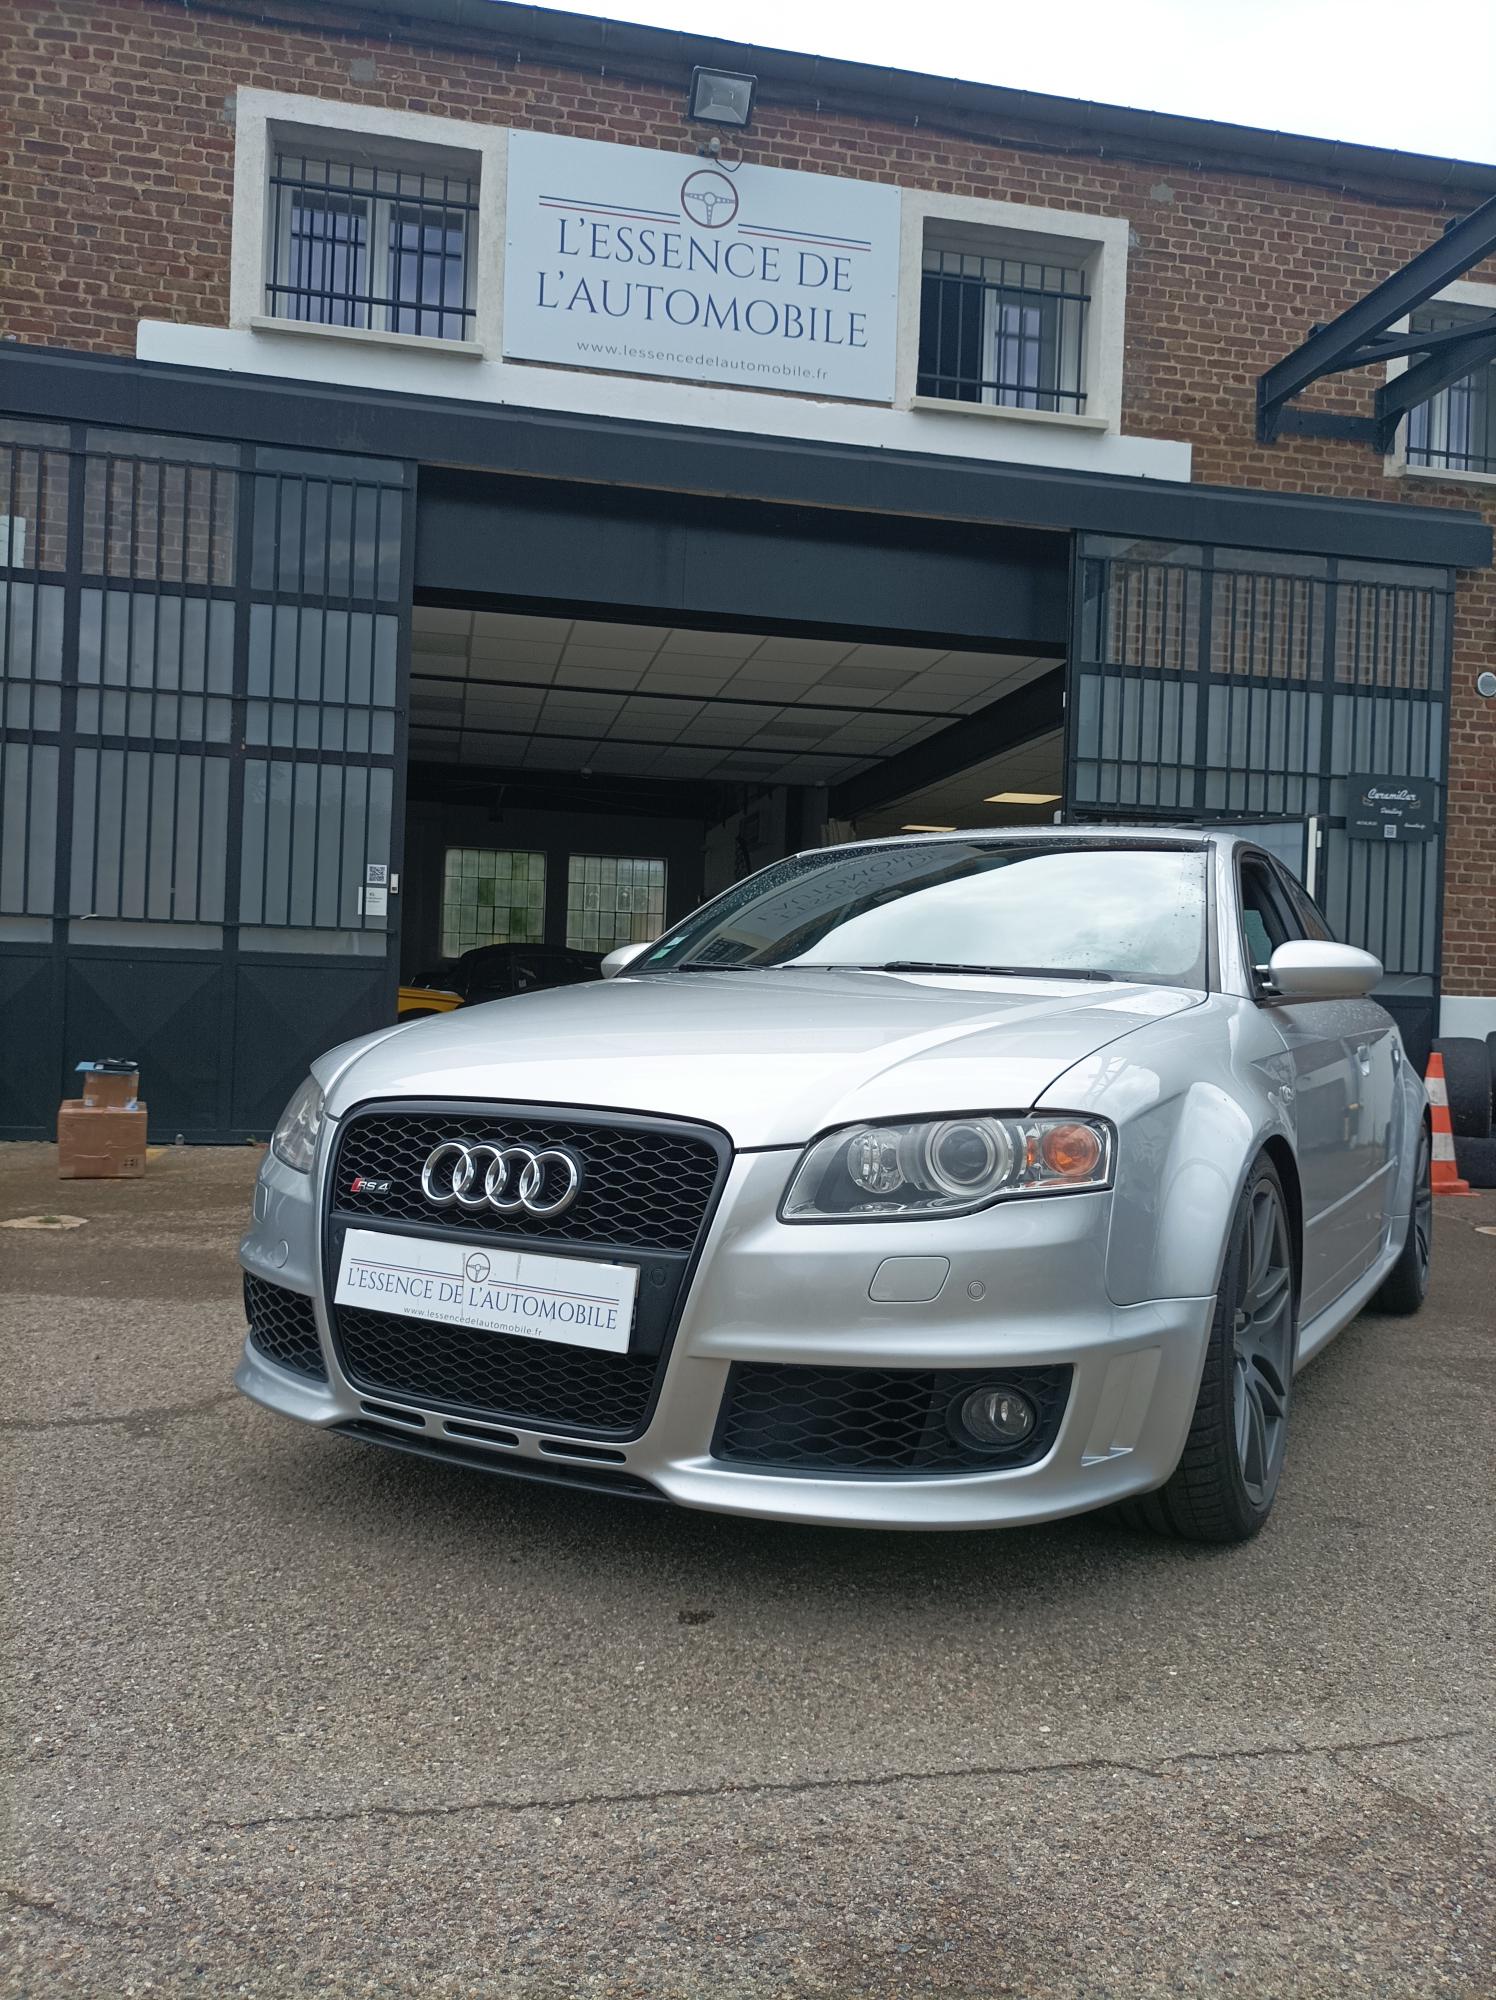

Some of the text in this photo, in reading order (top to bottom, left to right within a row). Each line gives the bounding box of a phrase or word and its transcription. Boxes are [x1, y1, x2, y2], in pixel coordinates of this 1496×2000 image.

[557, 217, 853, 293] L'ESSENCE DE
[537, 270, 868, 349] L'AUTOMOBILE
[576, 341, 829, 380] www.lessencedelautomobile.fr
[347, 1267, 618, 1330] L'ESSENCE DE L'AUTOMOBILE
[403, 1306, 543, 1337] www.lessencedelautomobile.fr
